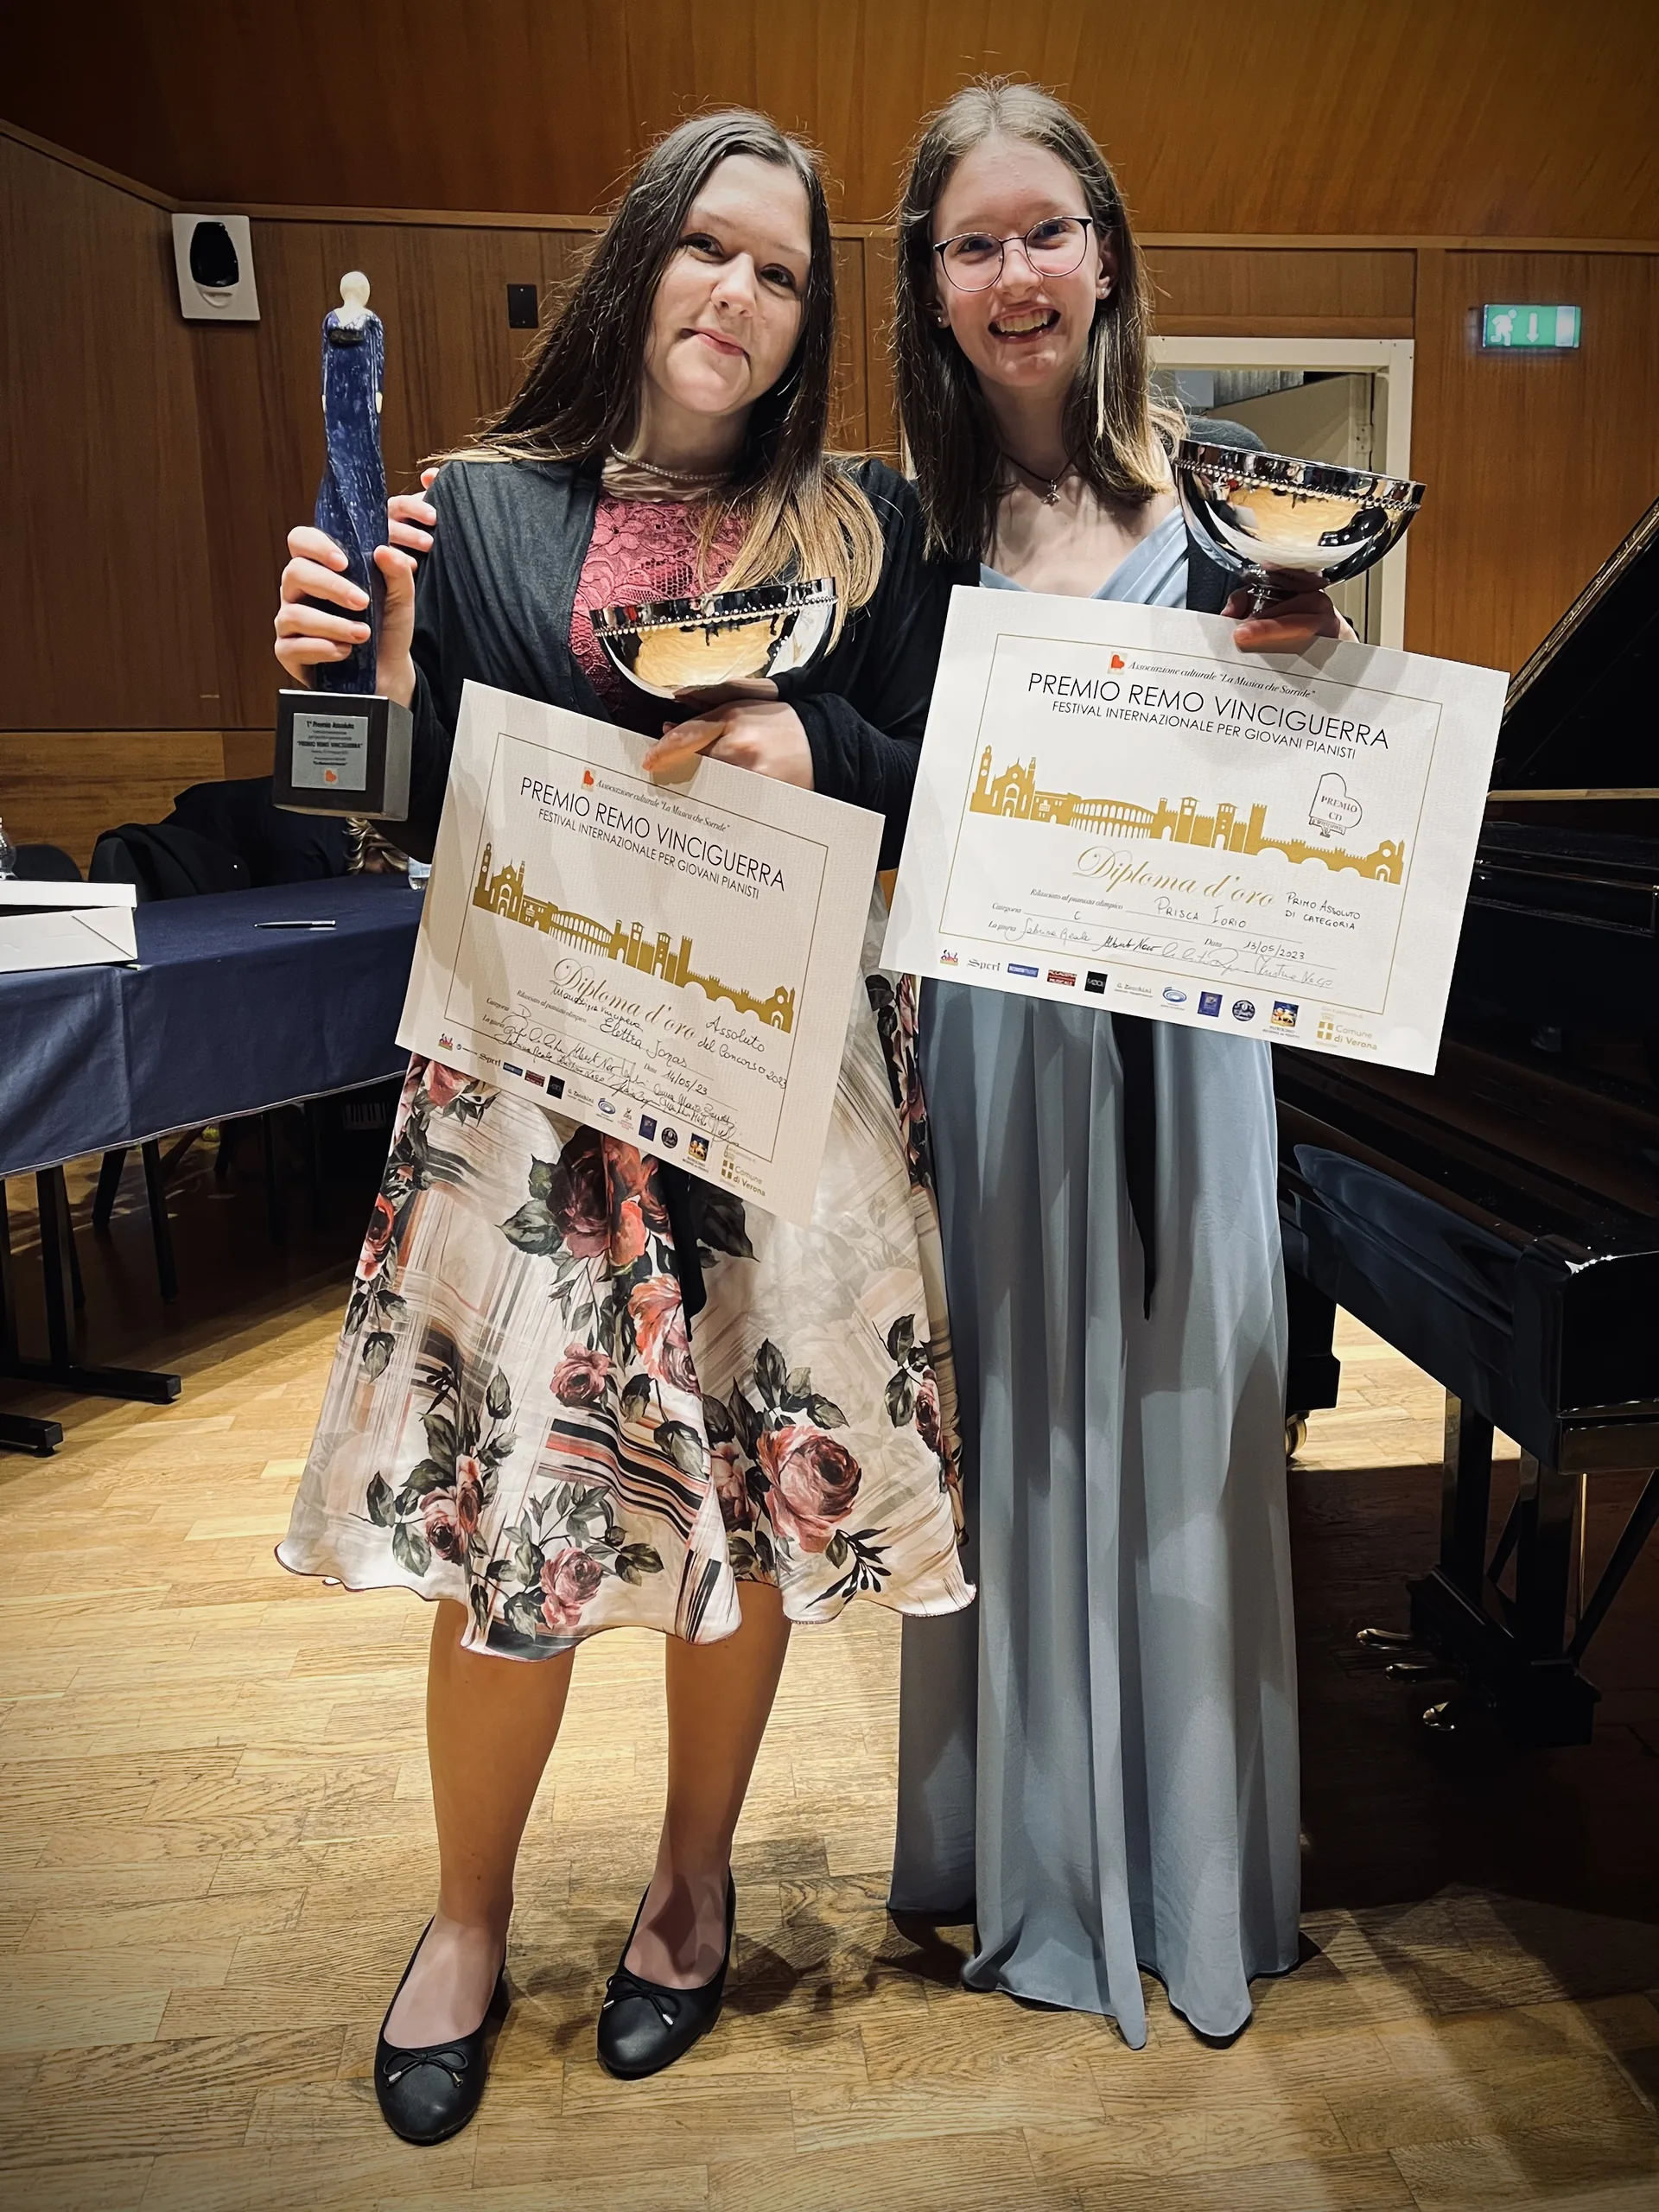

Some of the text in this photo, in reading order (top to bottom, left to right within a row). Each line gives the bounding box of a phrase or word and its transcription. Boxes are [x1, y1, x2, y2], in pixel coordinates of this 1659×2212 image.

[1128, 661, 1180, 675] Associazione
[1180, 668, 1217, 680] culturale
[1234, 677, 1264, 689] Musica
[1264, 683, 1280, 692] che
[1028, 672, 1389, 749] PREMIO REMO VINCIGUERRA
[1052, 701, 1357, 760] FESTIVAL INTERNAZIONALE PER GIOVANI PIANISTI
[596, 779, 633, 798] Associazione
[633, 793, 659, 807] culturale
[671, 805, 692, 820] Musica
[692, 813, 703, 823] che
[1321, 795, 1357, 813] PREMIO
[1328, 811, 1343, 822] CD
[520, 776, 785, 892] PREMIO REMO VINCIGUERRA
[538, 808, 760, 899] FESTIVAL INTERNAZIONALE PER GIOVANI PIANISTI
[1072, 846, 1274, 907] Diploma d'oro
[1074, 911, 1081, 920] C
[1154, 896, 1198, 921] PRISCA
[1285, 909, 1355, 930] DI CATEGORIA
[988, 920, 996, 929] La
[1243, 940, 1306, 961] 13/05/2023
[550, 957, 641, 1018] Diploma
[645, 1003, 696, 1040] d'oro
[600, 1017, 641, 1050] Elettra
[706, 1015, 765, 1052] Assoluto
[1334, 1034, 1343, 1043] di
[1345, 1036, 1377, 1051] Verona
[1336, 1025, 1372, 1039] Comune
[697, 1036, 787, 1090] del Concorso 2023
[662, 1070, 708, 1096] 14/05/23
[733, 1175, 741, 1184] di
[742, 1179, 766, 1197] Verona
[734, 1166, 763, 1185] Comune
